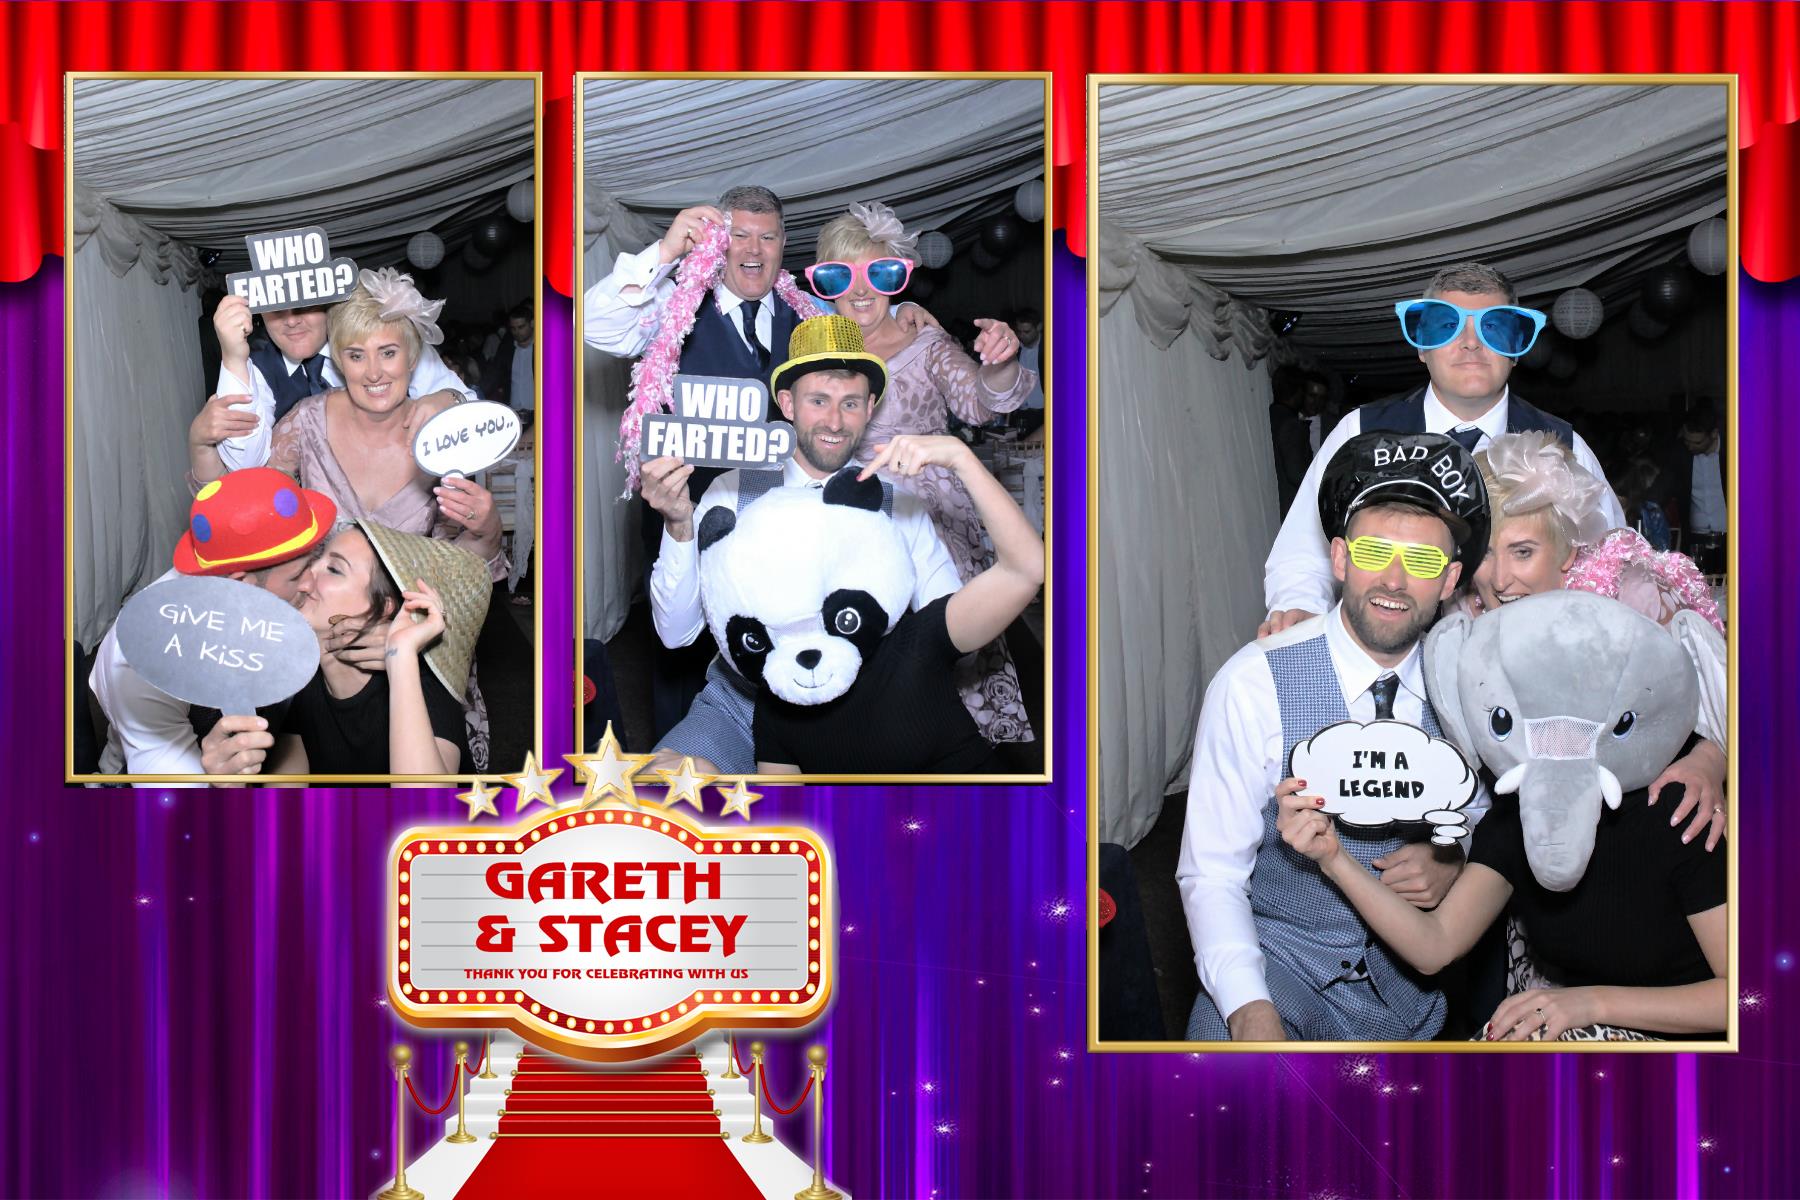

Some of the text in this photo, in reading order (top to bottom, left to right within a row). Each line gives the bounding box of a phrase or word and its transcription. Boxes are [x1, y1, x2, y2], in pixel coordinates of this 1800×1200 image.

[254, 232, 324, 271] WHO
[233, 264, 353, 308] FARTED?
[681, 382, 762, 422] WHO
[422, 441, 431, 456] I
[435, 428, 470, 452] LOVE
[647, 421, 790, 463] FARTED?
[1374, 445, 1470, 500] BAD BOY
[163, 633, 183, 657] A
[240, 617, 286, 642] ME
[1352, 750, 1409, 770] I'M A
[1339, 778, 1425, 799] LEGEND
